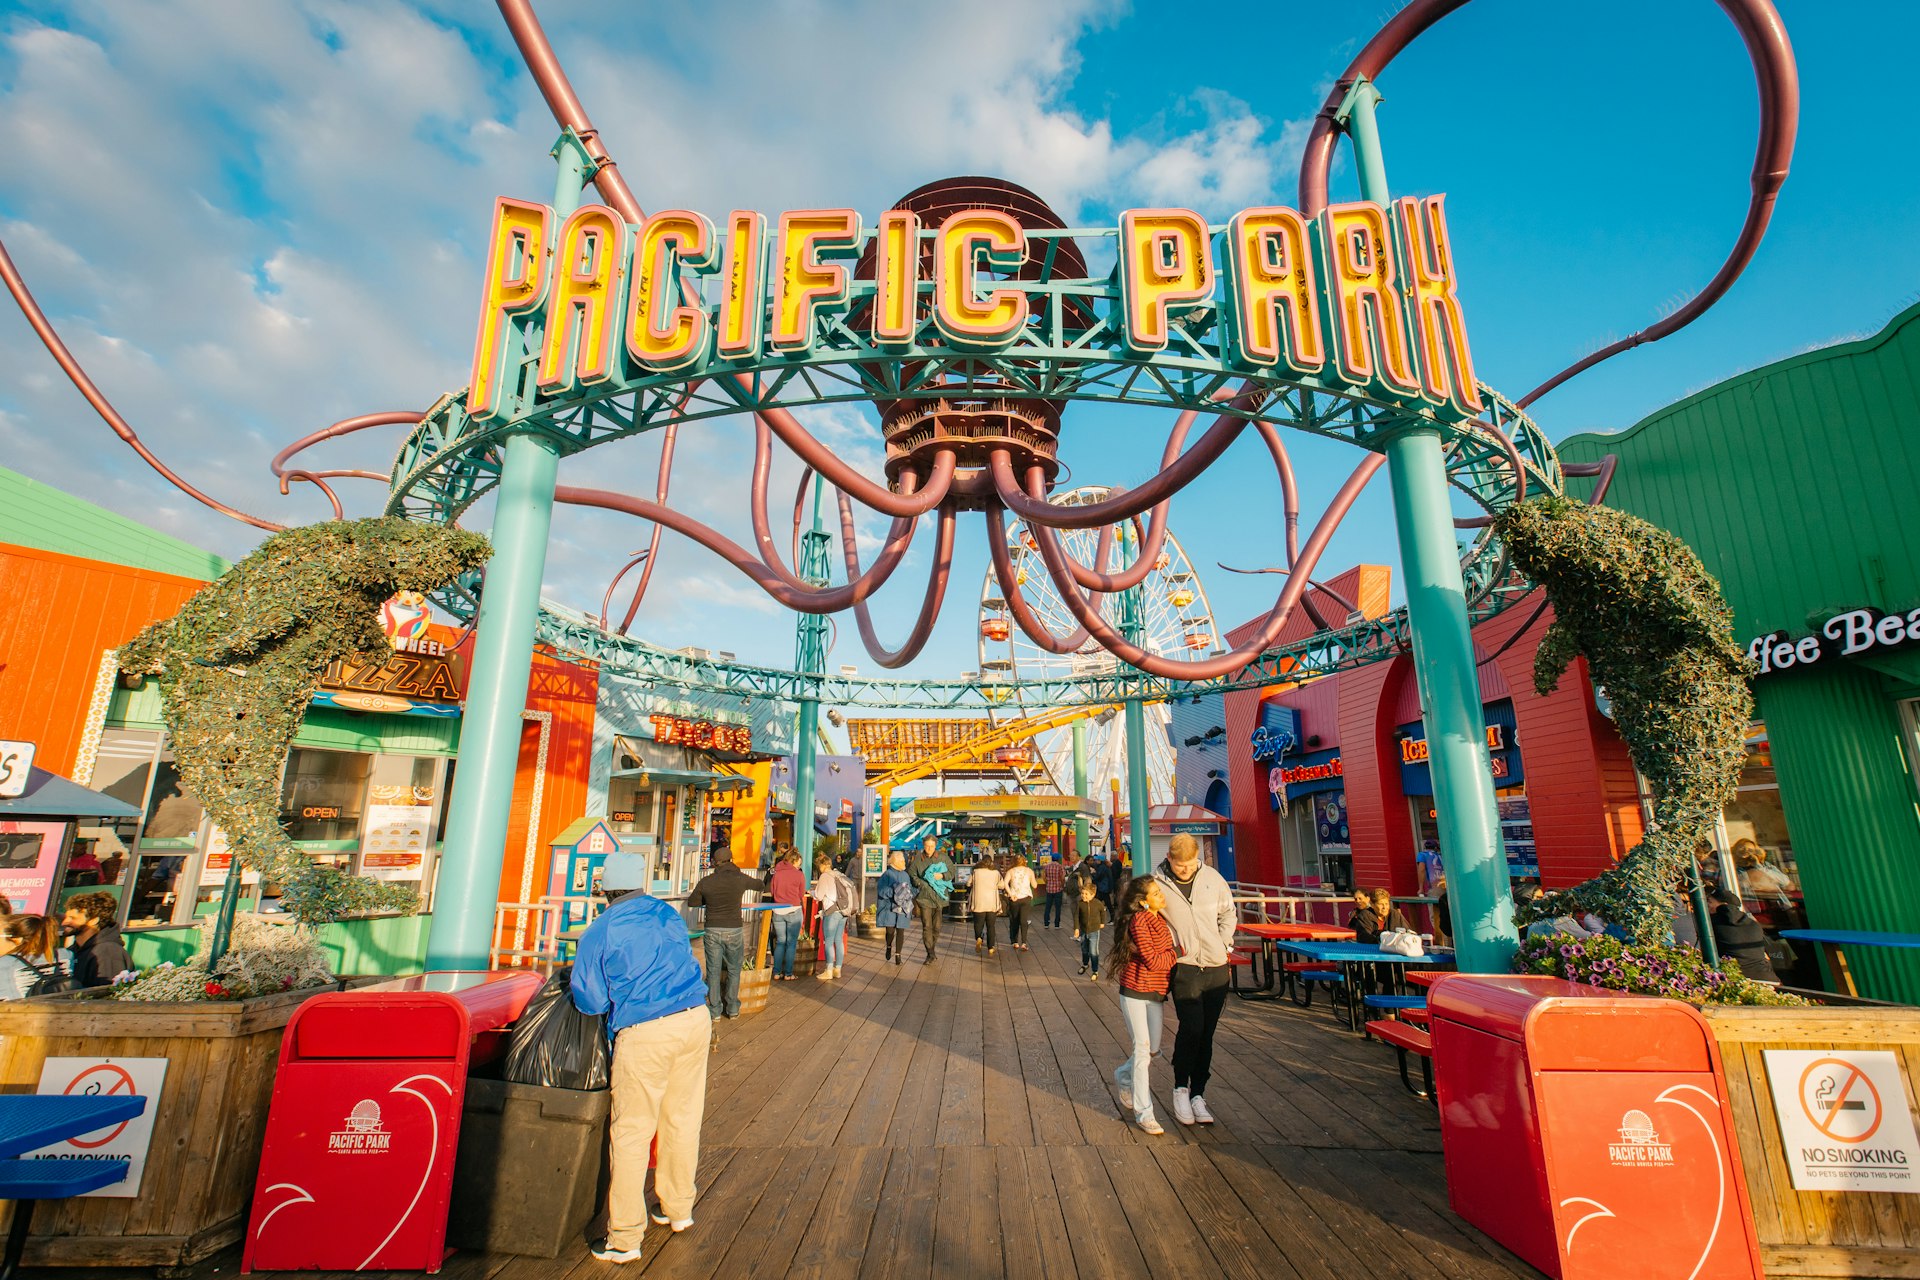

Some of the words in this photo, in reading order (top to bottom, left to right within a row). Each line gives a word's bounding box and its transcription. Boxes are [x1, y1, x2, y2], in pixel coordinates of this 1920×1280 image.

[466, 195, 1028, 421] PACIFIC
[1118, 192, 1484, 417] PARK
[395, 635, 446, 657] WHEEL
[1747, 633, 1821, 674] ffee
[321, 651, 460, 700] IZZA
[360, 697, 389, 710] CO.
[649, 714, 753, 755] TACOS
[1400, 738, 1429, 761] ICE
[302, 807, 338, 818] OPEN
[614, 812, 635, 822] OPEN
[0, 877, 46, 888] MEMORIES
[2, 888, 32, 897] Booth
[328, 1134, 365, 1149] PACIFIC
[365, 1134, 391, 1149] PARK
[1608, 1146, 1646, 1161] PACIFIC
[1646, 1146, 1674, 1161] PARK
[1801, 1148, 1826, 1162] NO
[1826, 1148, 1908, 1164] SMOKING
[1806, 1170, 1818, 1178] NO
[1818, 1170, 1837, 1178] PETS
[1889, 1172, 1911, 1180] POINT
